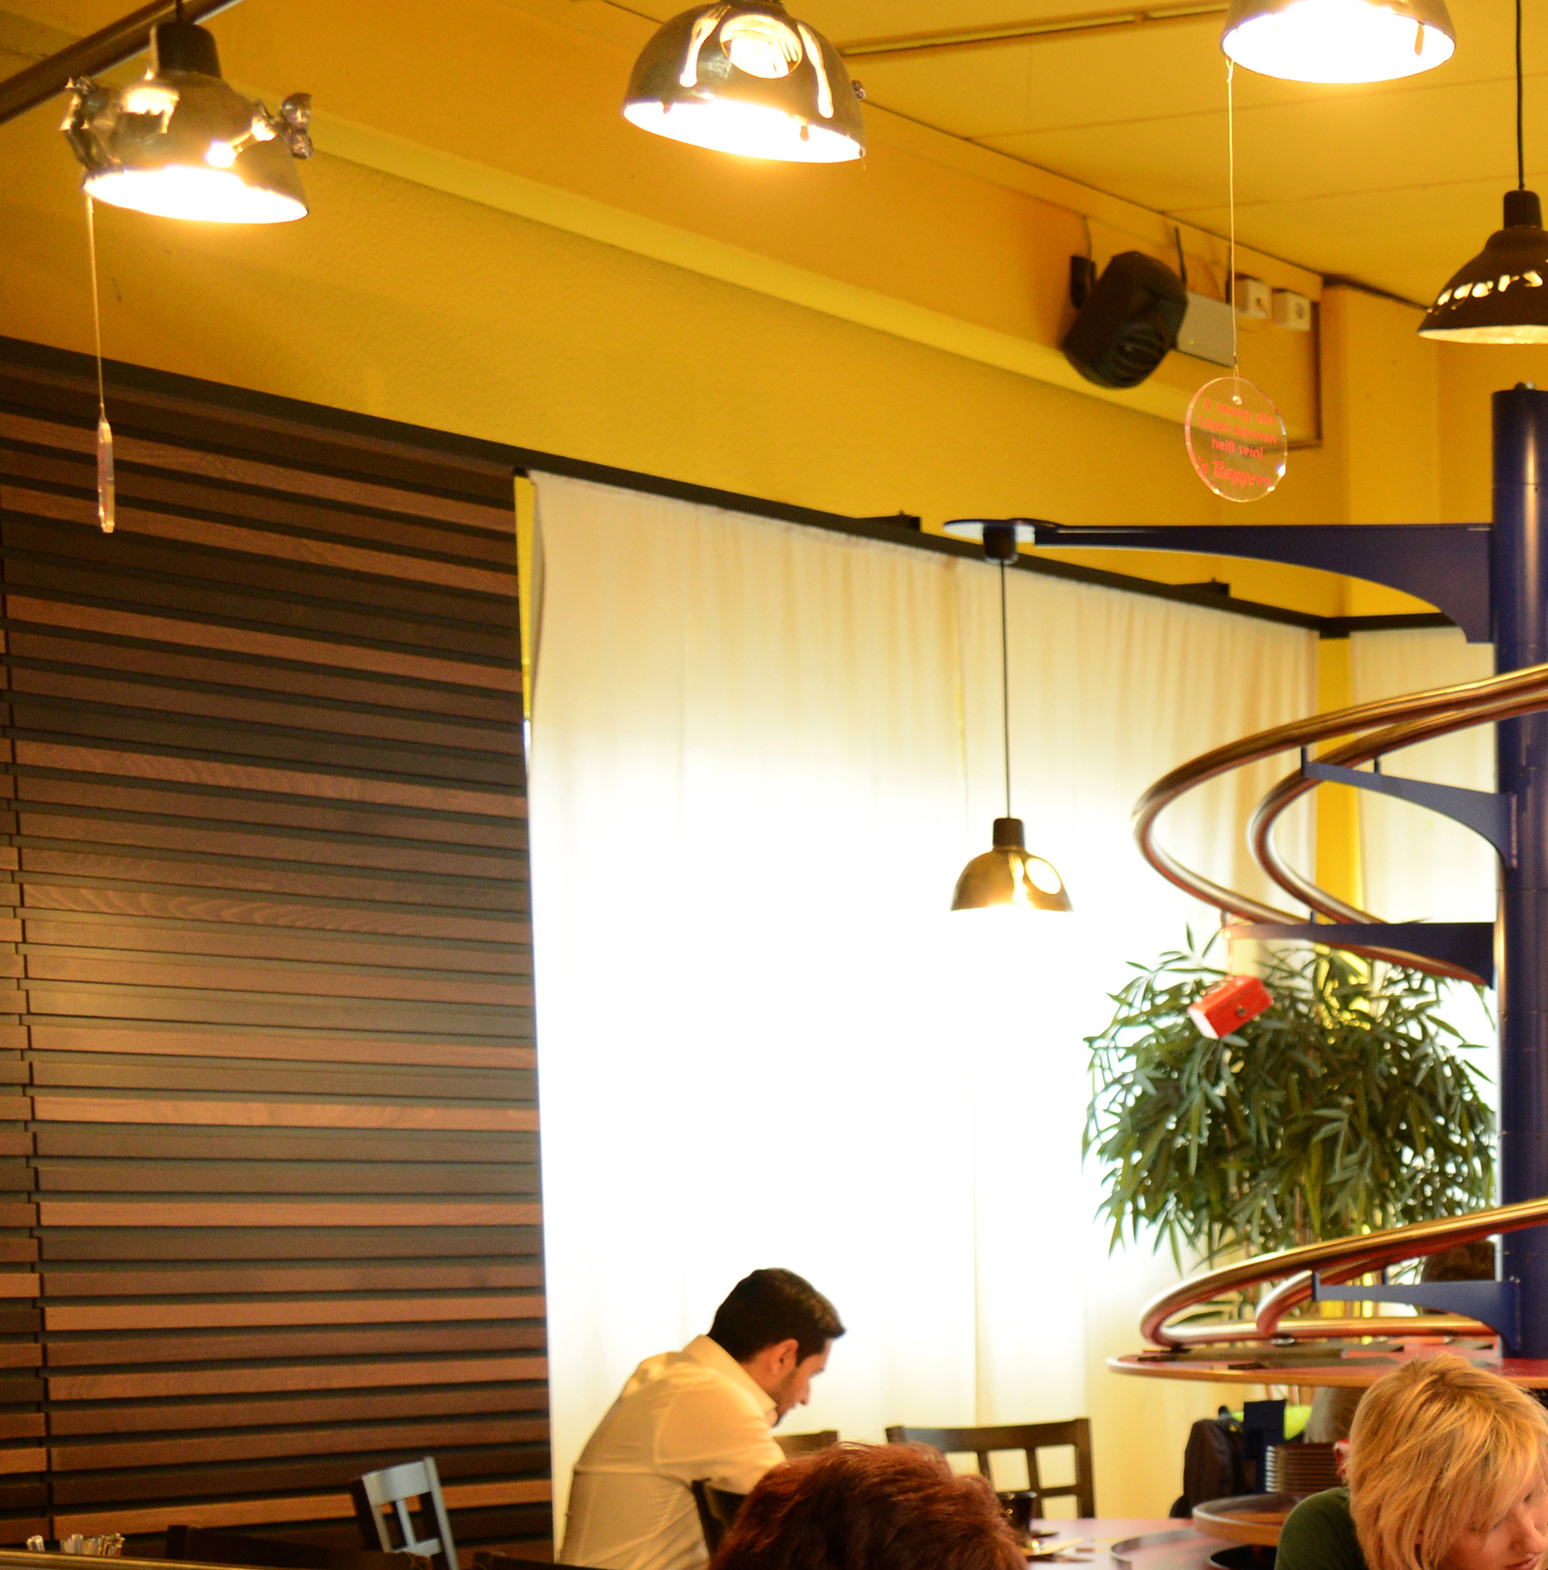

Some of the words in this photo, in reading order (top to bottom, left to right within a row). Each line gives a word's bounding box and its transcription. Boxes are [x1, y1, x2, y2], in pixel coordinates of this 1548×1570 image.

[1203, 398, 1253, 422] Ahtung,
[1256, 411, 1275, 425] die
[1234, 424, 1278, 444] können
[1211, 437, 1236, 453] heiß
[1238, 445, 1264, 459] sein!
